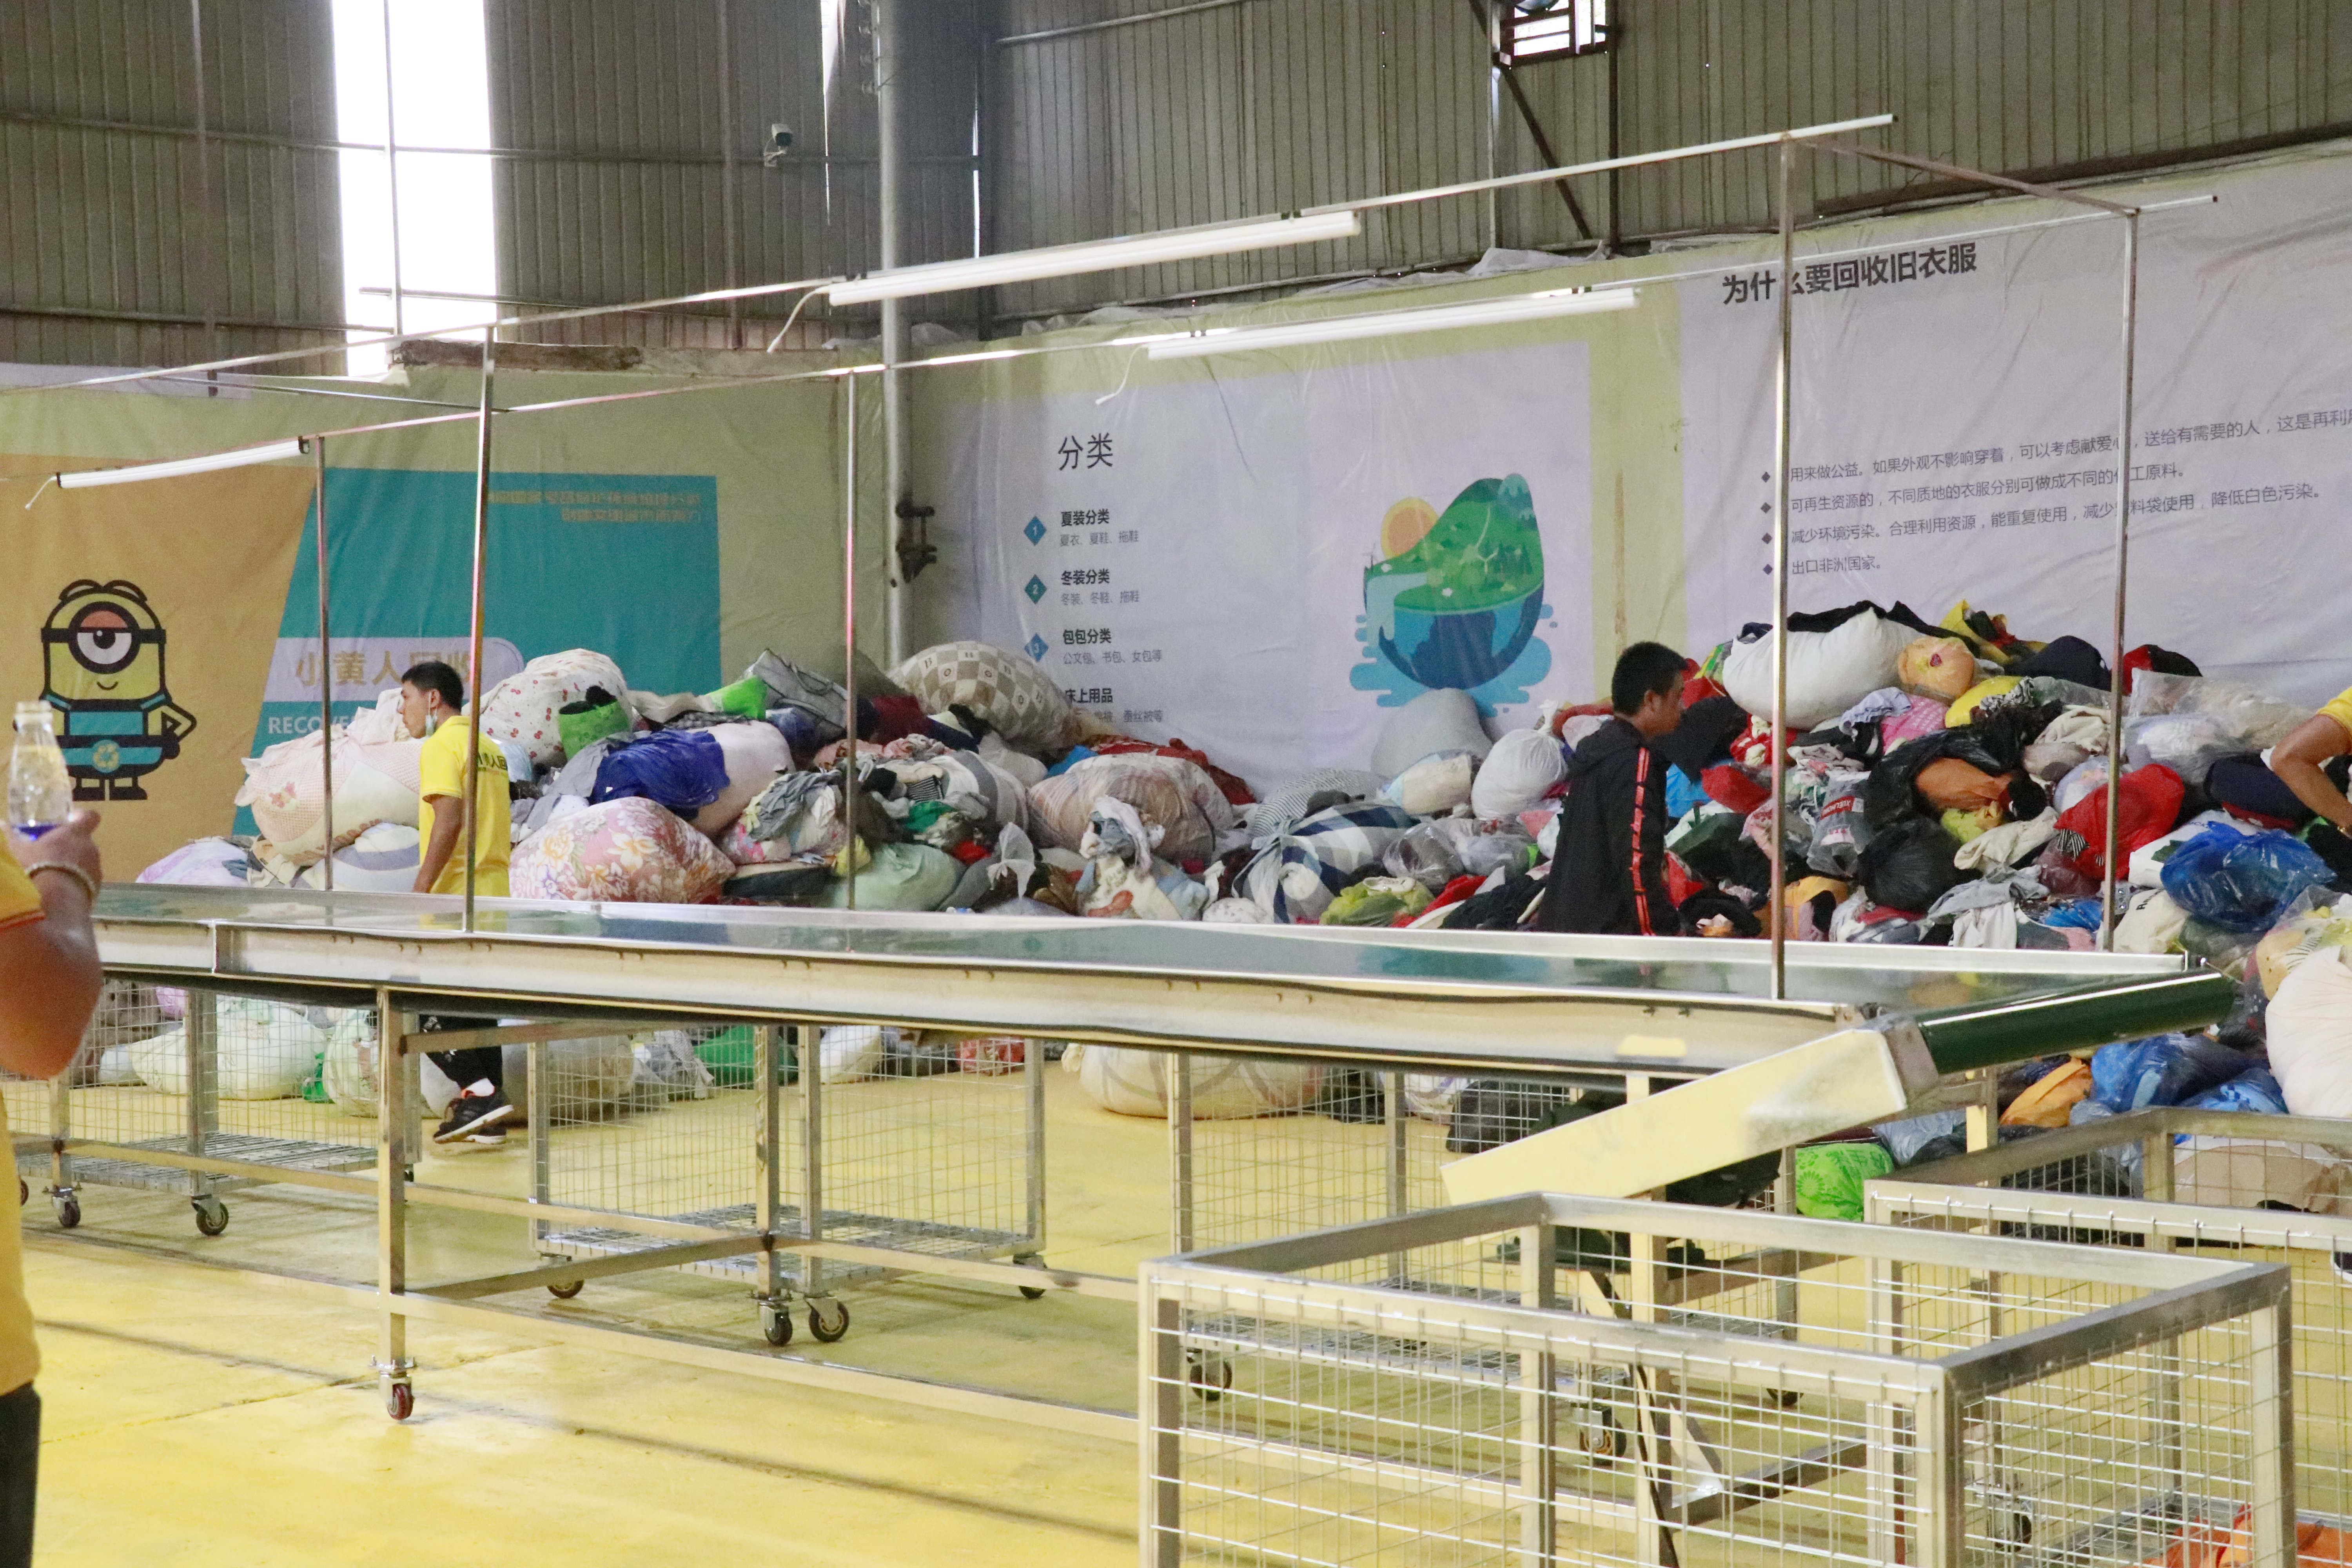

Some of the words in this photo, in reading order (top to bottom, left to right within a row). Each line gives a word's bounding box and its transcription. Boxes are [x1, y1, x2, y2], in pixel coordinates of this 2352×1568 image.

[1058, 432, 1113, 470] 分类
[1061, 508, 1110, 527] 夏装分类
[1791, 483, 2319, 543] 减少环境污染。合理利用资源，能重复使用，减少料袋使用，降低白色污染。
[1033, 525, 1037, 536] 1
[1792, 555, 1881, 575] 出口非洲国家。
[1061, 567, 1110, 585] 冬装分类
[1033, 584, 1039, 595] 2
[1063, 628, 1112, 645] 包包分类
[296, 650, 472, 686] 小黄人
[1065, 688, 1114, 704] 床上用品
